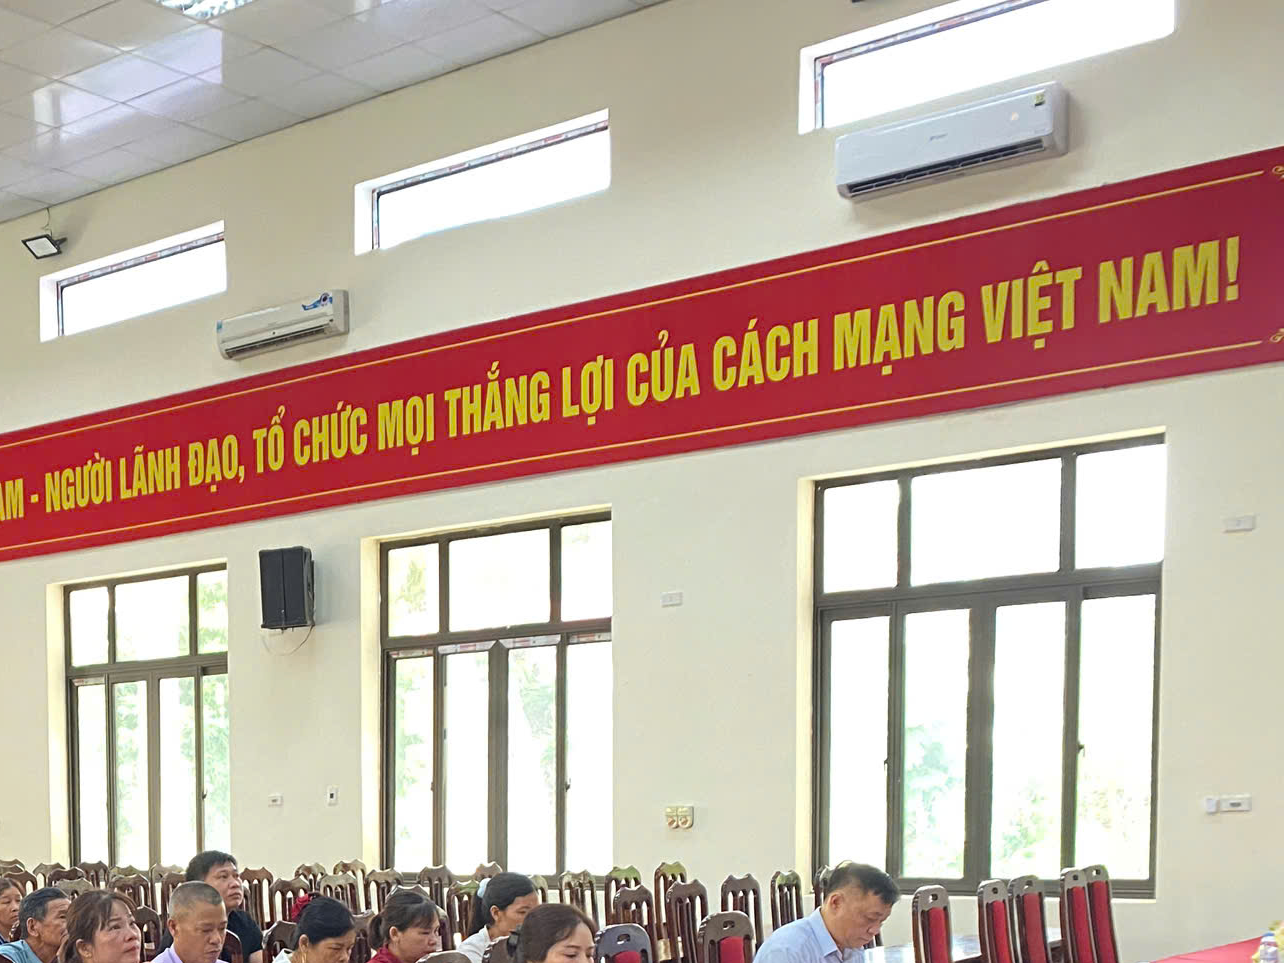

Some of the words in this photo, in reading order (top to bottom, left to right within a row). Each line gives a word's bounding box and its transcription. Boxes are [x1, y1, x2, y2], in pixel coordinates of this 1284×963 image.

[45, 453, 113, 513] NGƯỜI
[119, 445, 181, 500] LÃNH
[188, 435, 246, 494] ĐẠO,
[252, 406, 285, 473] TỔ
[293, 401, 369, 465] CHỨC
[377, 394, 435, 455] MỌI
[443, 361, 550, 438] THẮNG
[562, 355, 614, 425] LỢI
[627, 329, 701, 407] CỦA
[713, 319, 818, 392] CÁCH
[833, 291, 965, 376] MẠNG
[981, 260, 1082, 349] VIỆT
[1099, 236, 1240, 323] NAM!
